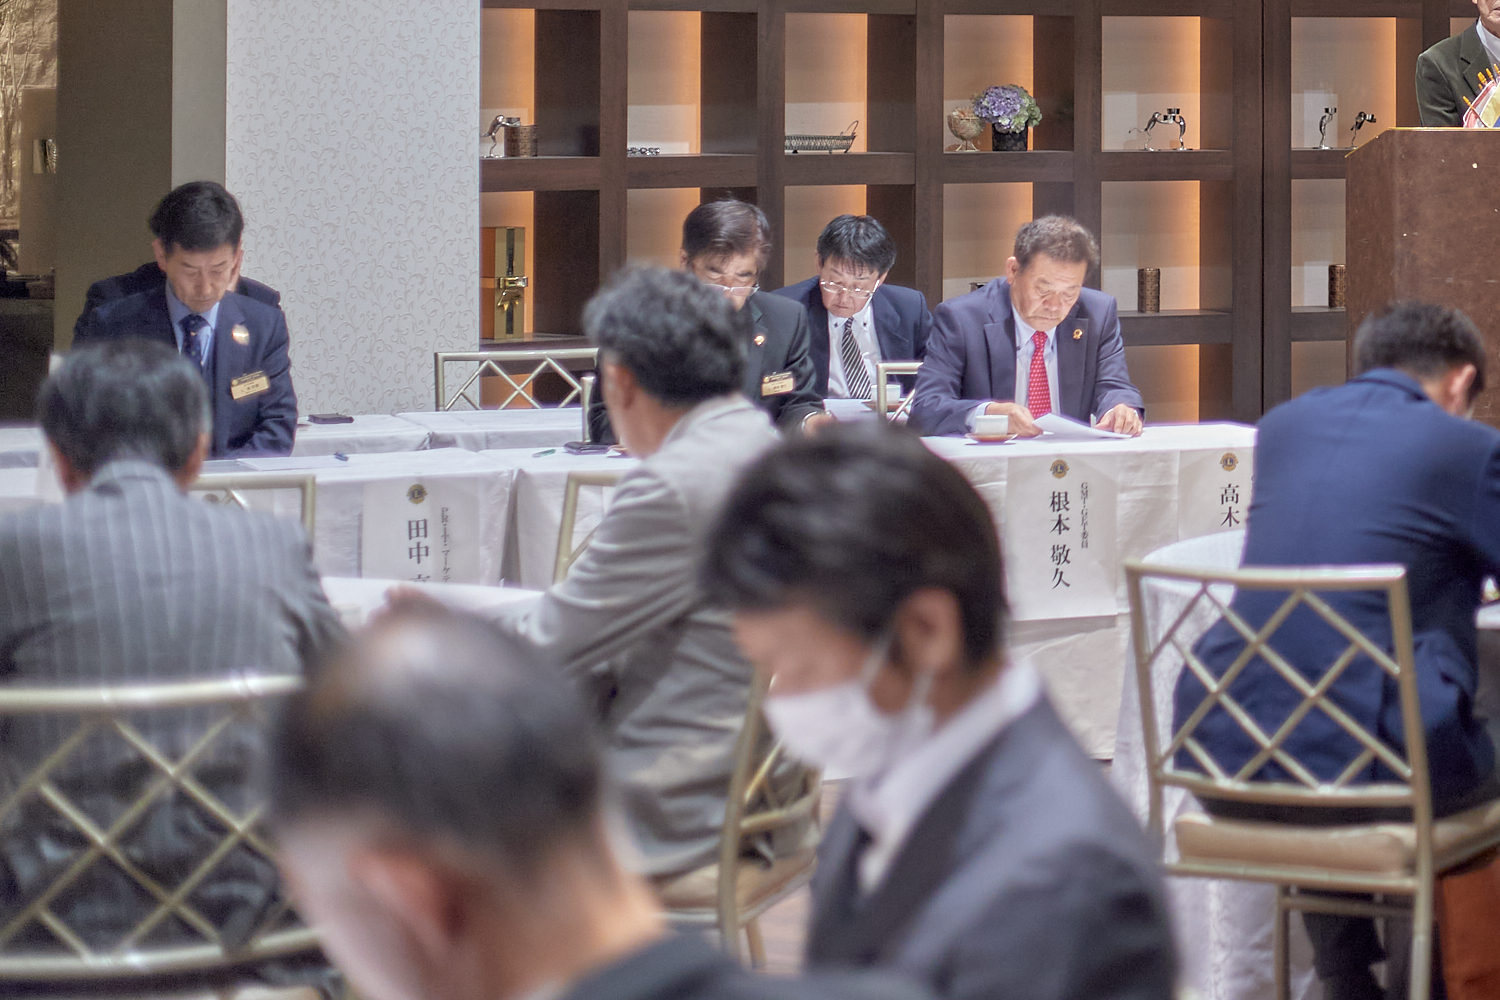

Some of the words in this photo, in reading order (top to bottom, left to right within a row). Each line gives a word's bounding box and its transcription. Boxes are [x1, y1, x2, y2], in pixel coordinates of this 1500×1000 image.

[1049, 490, 1071, 535] 根本
[1220, 483, 1241, 527] 高木
[408, 518, 429, 565] 田中
[1050, 543, 1071, 589] 敬久
